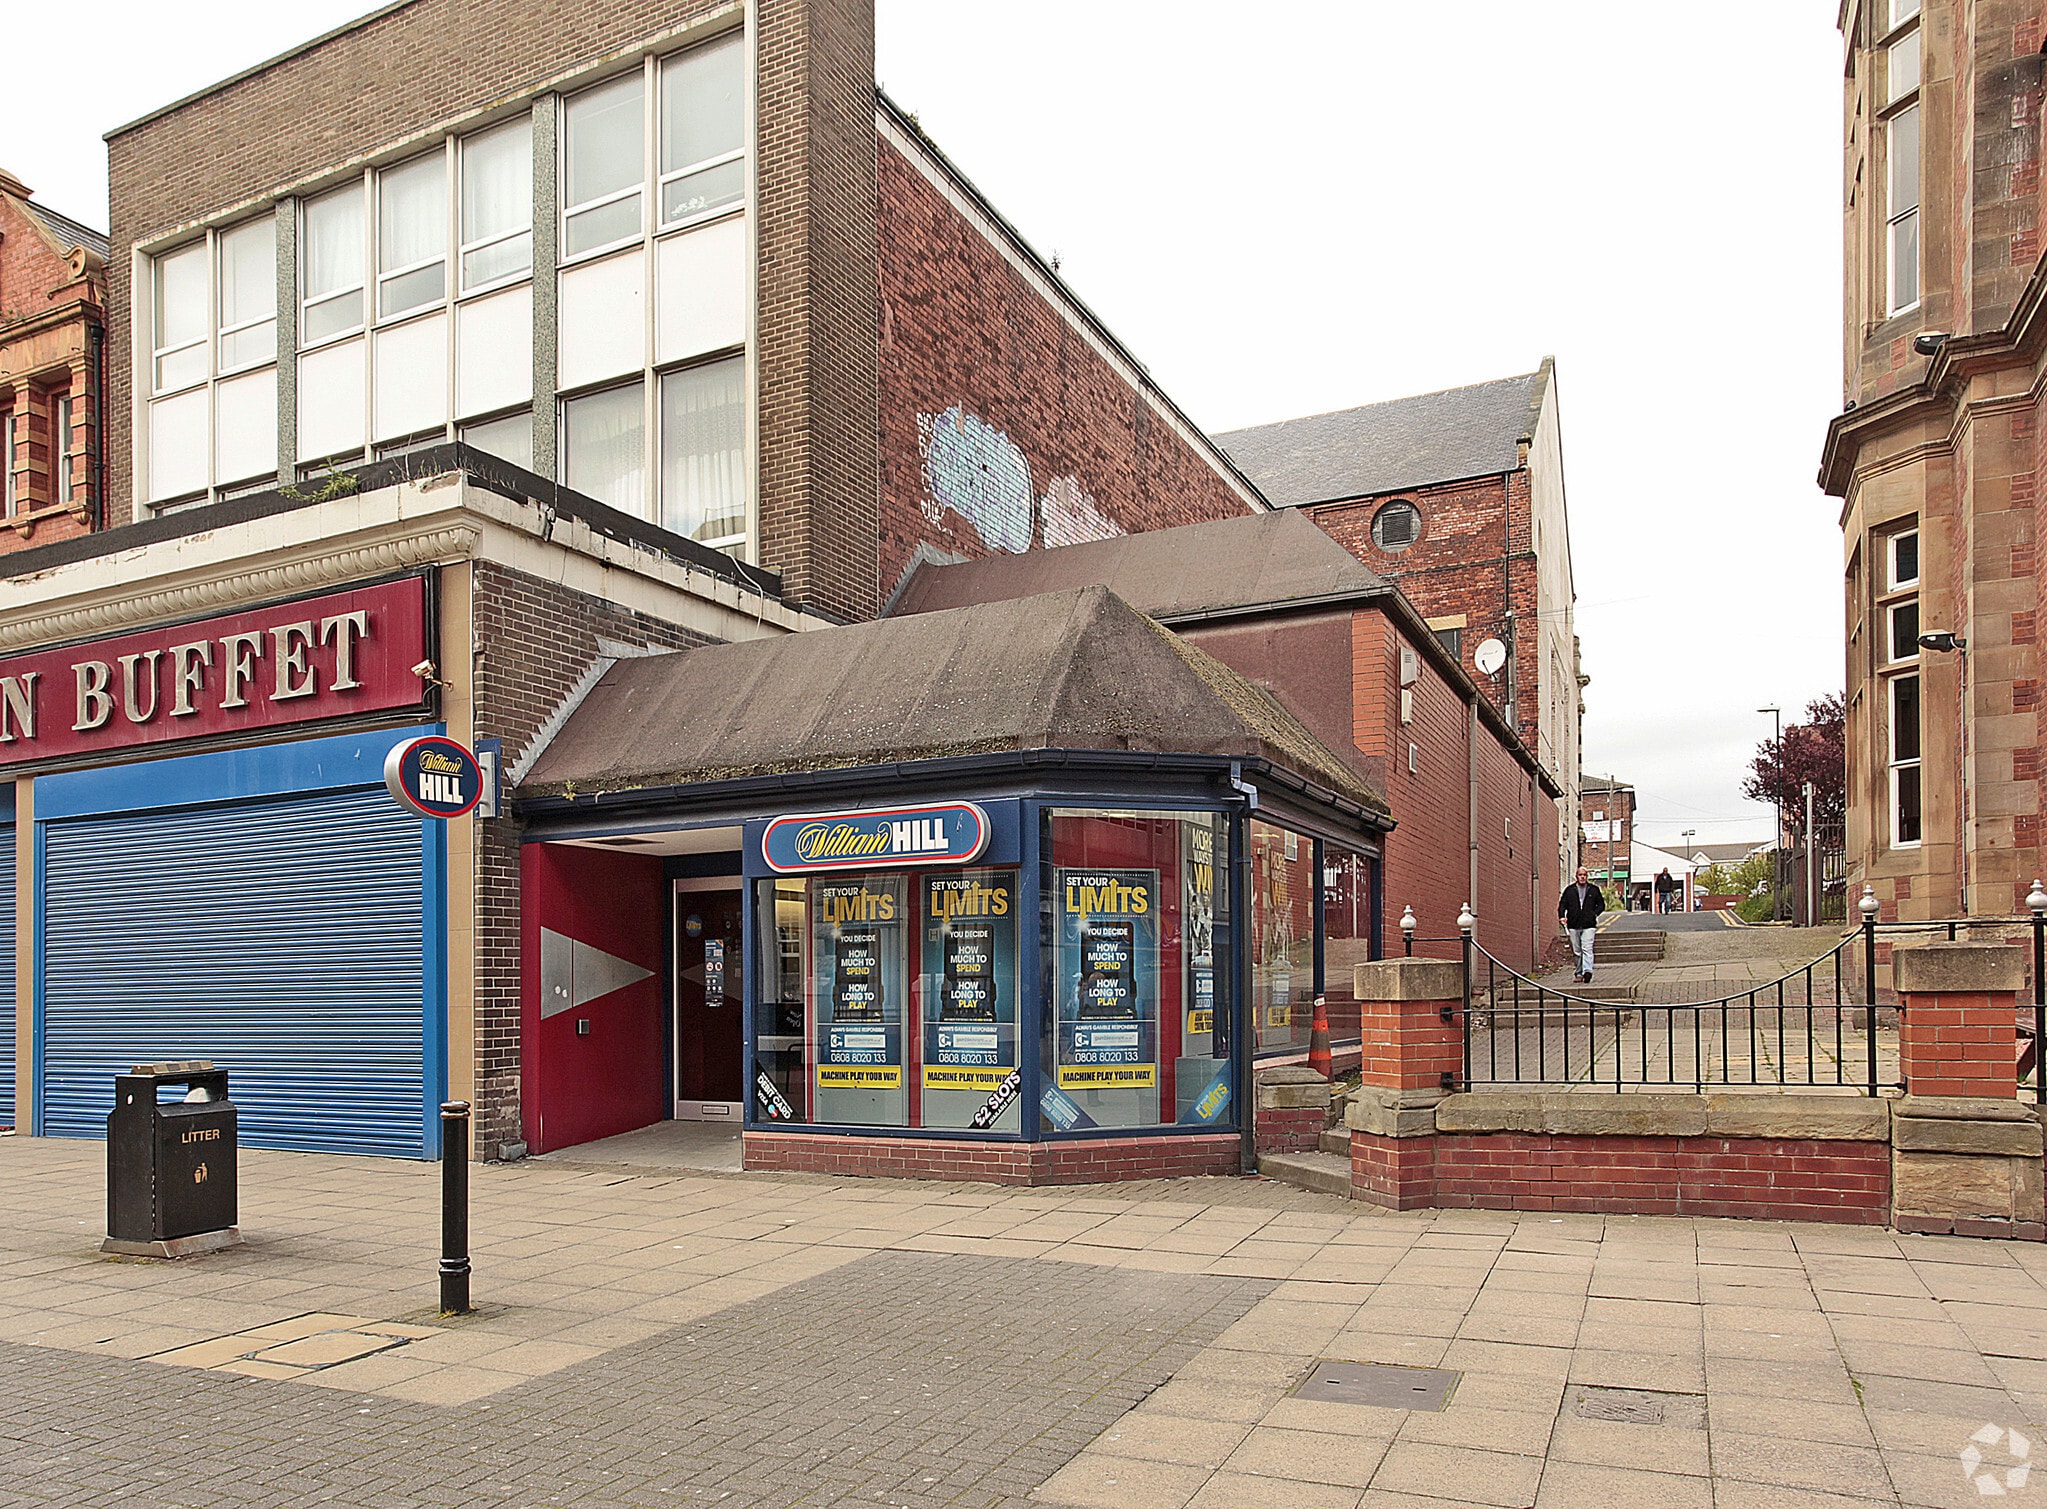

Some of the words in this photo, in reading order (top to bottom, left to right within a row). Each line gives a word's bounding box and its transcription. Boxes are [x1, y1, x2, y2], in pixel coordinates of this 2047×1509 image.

[71, 610, 370, 731] BUFFET
[419, 750, 463, 773] William
[419, 773, 464, 804] HILL
[796, 821, 892, 861] William
[892, 818, 949, 852] HILL
[1192, 828, 1212, 853] MORE
[931, 882, 946, 890] SET
[946, 880, 970, 889] YOUR
[1066, 877, 1082, 886] SET
[1082, 877, 1108, 886] YOUR
[823, 888, 836, 897] SET
[836, 887, 859, 896] YOUR
[931, 882, 1008, 923] LIMITS
[1066, 879, 1148, 919] LIMITS
[823, 888, 894, 928] LIMITS
[1087, 928, 1102, 936] YOU
[841, 935, 853, 943] YOU
[958, 946, 978, 954] HOW
[1096, 944, 1118, 952] HOW
[848, 950, 867, 958] HOW
[950, 955, 975, 963] MUCH
[975, 954, 987, 963] TO
[1088, 953, 1115, 961] MUCH
[1115, 953, 1127, 961] TO
[841, 959, 864, 967] MUCH
[1094, 962, 1121, 970] SPEND
[846, 967, 870, 975] SPEND
[956, 964, 981, 972] SPEND
[848, 984, 868, 992] HOW
[958, 981, 979, 990] HOW
[1096, 979, 1118, 988] HOW
[842, 992, 863, 1001] LONG
[951, 990, 973, 999] LONG
[974, 991, 986, 999] TO
[1089, 988, 1113, 997] LONG
[1115, 988, 1126, 997] TO
[849, 1001, 867, 1009] PLAY
[958, 999, 978, 1008] PLAY
[1097, 997, 1118, 1006] PLAY
[851, 1053, 871, 1063] 8020
[874, 1053, 886, 1063] 133
[938, 1054, 958, 1063] 0808
[961, 1055, 982, 1063] 8020
[984, 1055, 998, 1064] 133
[1075, 1052, 1097, 1062] 0808
[1099, 1052, 1122, 1062] 8020
[1124, 1051, 1138, 1061] 133
[821, 1071, 849, 1080] MACHINE
[849, 1071, 865, 1081] PLAY
[866, 1072, 882, 1081] YOUR
[883, 1072, 898, 1081] WAY
[927, 1071, 957, 1082] MACHINE
[959, 1072, 974, 1082] PLAY
[975, 1073, 993, 1082] YOUR
[1063, 1072, 1095, 1082] MACHINE
[1097, 1072, 1113, 1081] PLAY
[1114, 1071, 1133, 1081] YOUR
[1135, 1070, 1151, 1080] WAY
[757, 1075, 775, 1098] DEBIT
[772, 1096, 791, 1119] CARD
[975, 1106, 992, 1127] £2
[988, 1071, 1021, 1110] SLOTS
[1198, 1083, 1228, 1119] LIMITS
[181, 1129, 220, 1144] LITTER
